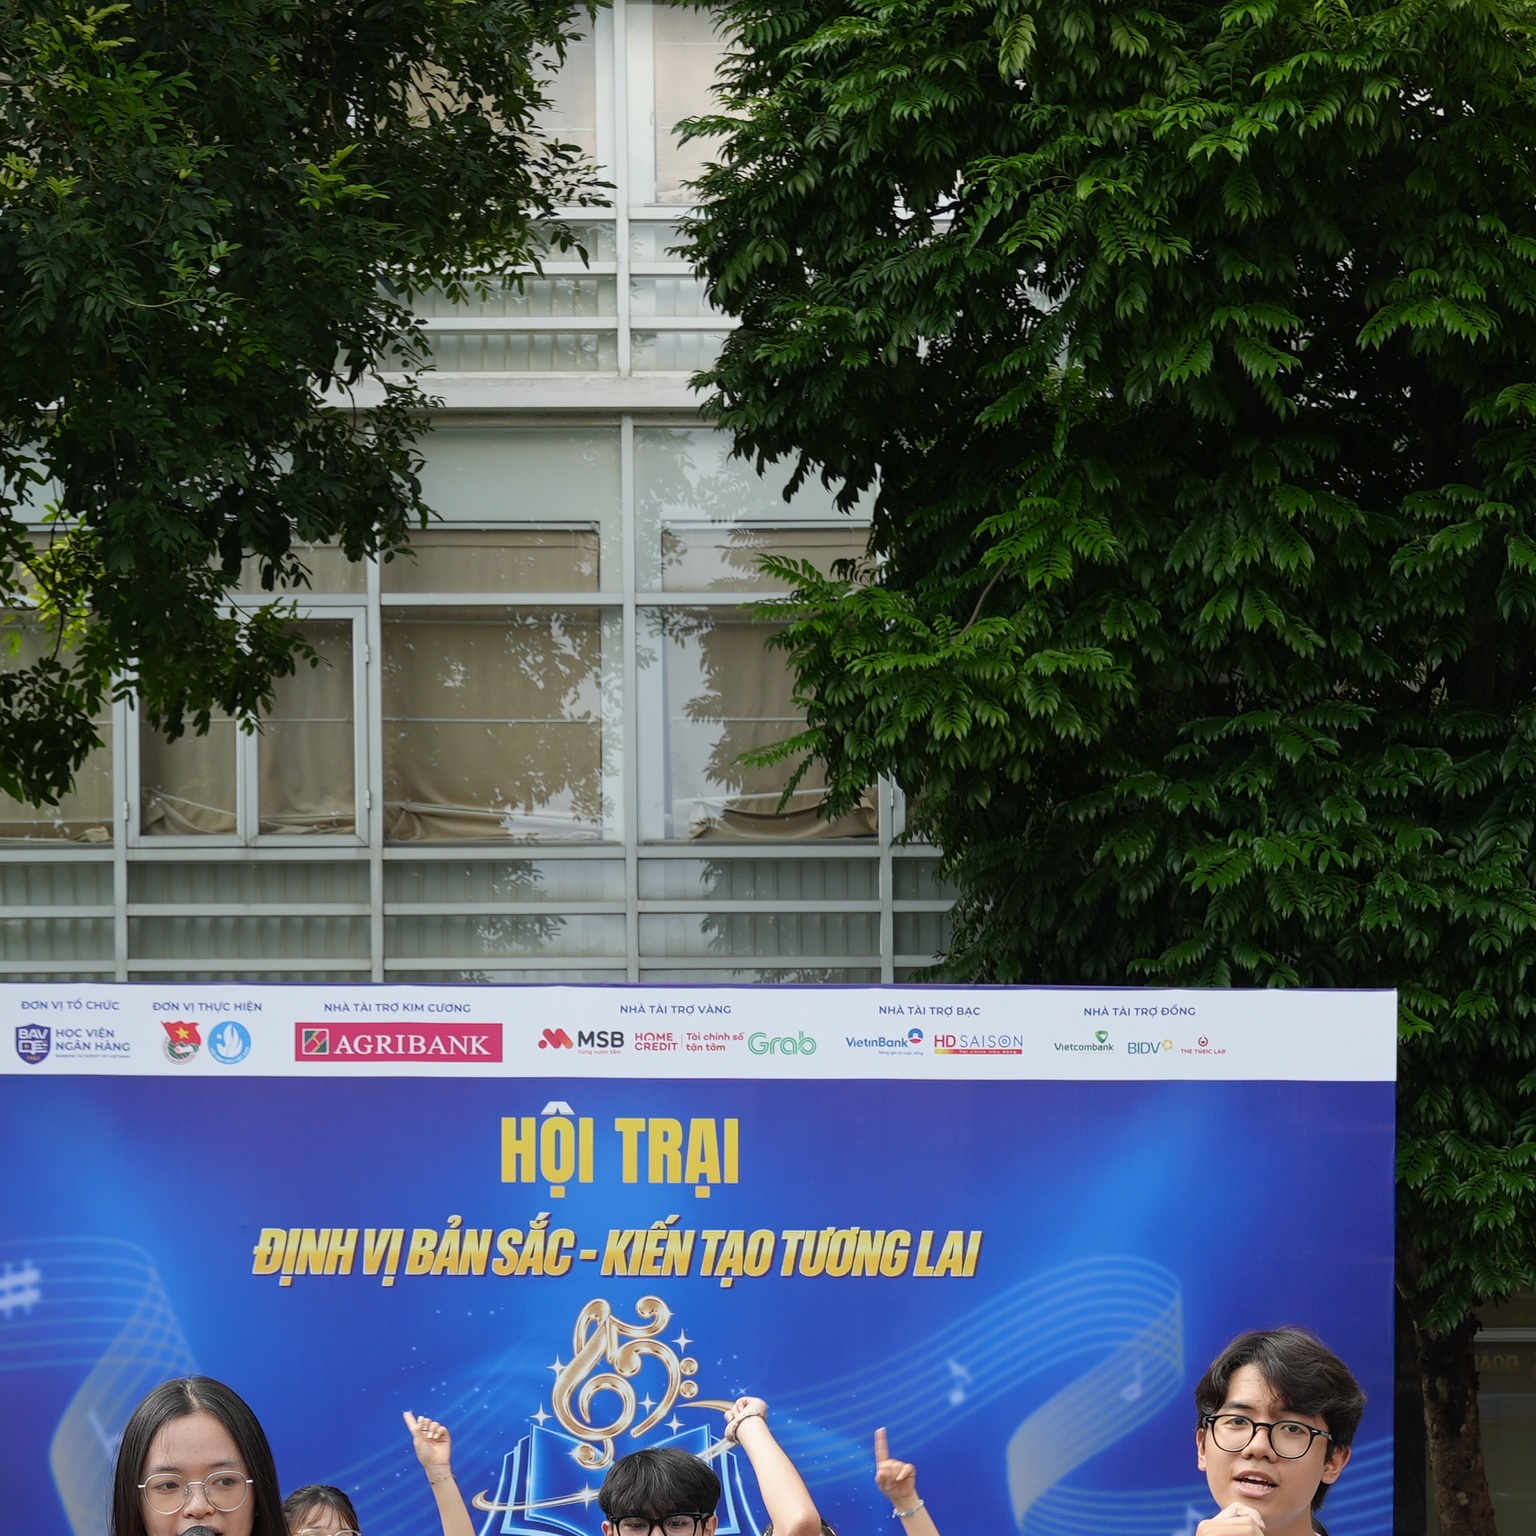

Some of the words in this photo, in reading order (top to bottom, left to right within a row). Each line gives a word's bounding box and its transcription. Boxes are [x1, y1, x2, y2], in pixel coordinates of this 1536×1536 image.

[21, 1000, 48, 1011] ĐƠN
[51, 1001, 64, 1013] VỊ
[67, 997, 83, 1011] TỔ
[88, 998, 120, 1011] CHỨC
[152, 1001, 180, 1012] ĐƠN
[182, 1002, 195, 1014] VỊ
[198, 1000, 230, 1013] THỰC
[233, 1001, 262, 1014] HIỆN
[324, 1001, 350, 1013] NHÀ
[354, 1001, 372, 1013] TÀI
[376, 1002, 399, 1014] TRỢ
[403, 1002, 424, 1013] KIM
[428, 1002, 471, 1013] CƯƠNG
[620, 1004, 645, 1015] NHÀ
[649, 1004, 668, 1015] TÀI
[671, 1004, 695, 1016] TRỢ
[697, 1004, 732, 1015] VÀNG
[878, 1005, 905, 1016] NHÀ
[907, 1005, 926, 1016] TÀI
[929, 1006, 953, 1017] TRỢ
[956, 1006, 981, 1018] BẠC
[1084, 1006, 1110, 1016] NHÀ
[1112, 1006, 1131, 1017] TÀI
[1134, 1005, 1158, 1018] TRỢ
[1161, 1004, 1196, 1017] ĐỒNG
[18, 1028, 49, 1040] BAV
[55, 1028, 82, 1040] HỌC
[85, 1027, 115, 1040] VIỆN
[578, 1030, 625, 1048] MSB
[635, 1032, 673, 1041] HOME
[686, 1031, 701, 1041] Tài
[703, 1031, 731, 1041] chính
[732, 1031, 745, 1041] số
[55, 1040, 91, 1051] NGÂN
[95, 1040, 131, 1052] HÀNG
[334, 1034, 491, 1056] AGRIBANK
[635, 1042, 678, 1051] CREDIT
[686, 1042, 702, 1053] tận
[703, 1042, 726, 1051] tâm
[748, 1030, 817, 1056] Grab
[845, 1036, 908, 1048] VietinBank
[934, 1034, 956, 1048] HD
[959, 1034, 1024, 1048] SAISON
[1054, 1041, 1114, 1051] Vietcombank
[1127, 1042, 1161, 1054] BIDV
[500, 1101, 594, 1198] HỘI
[614, 1116, 739, 1198] TRẠI
[252, 1227, 357, 1287] ĐỊNH
[361, 1227, 403, 1287] VỊ
[404, 1216, 493, 1277] BẢN
[491, 1211, 575, 1277] SẮC
[600, 1214, 691, 1277] KIẾN
[698, 1228, 772, 1288] TẠO
[779, 1227, 914, 1278] TƯƠNG
[912, 1229, 985, 1278] LAI
